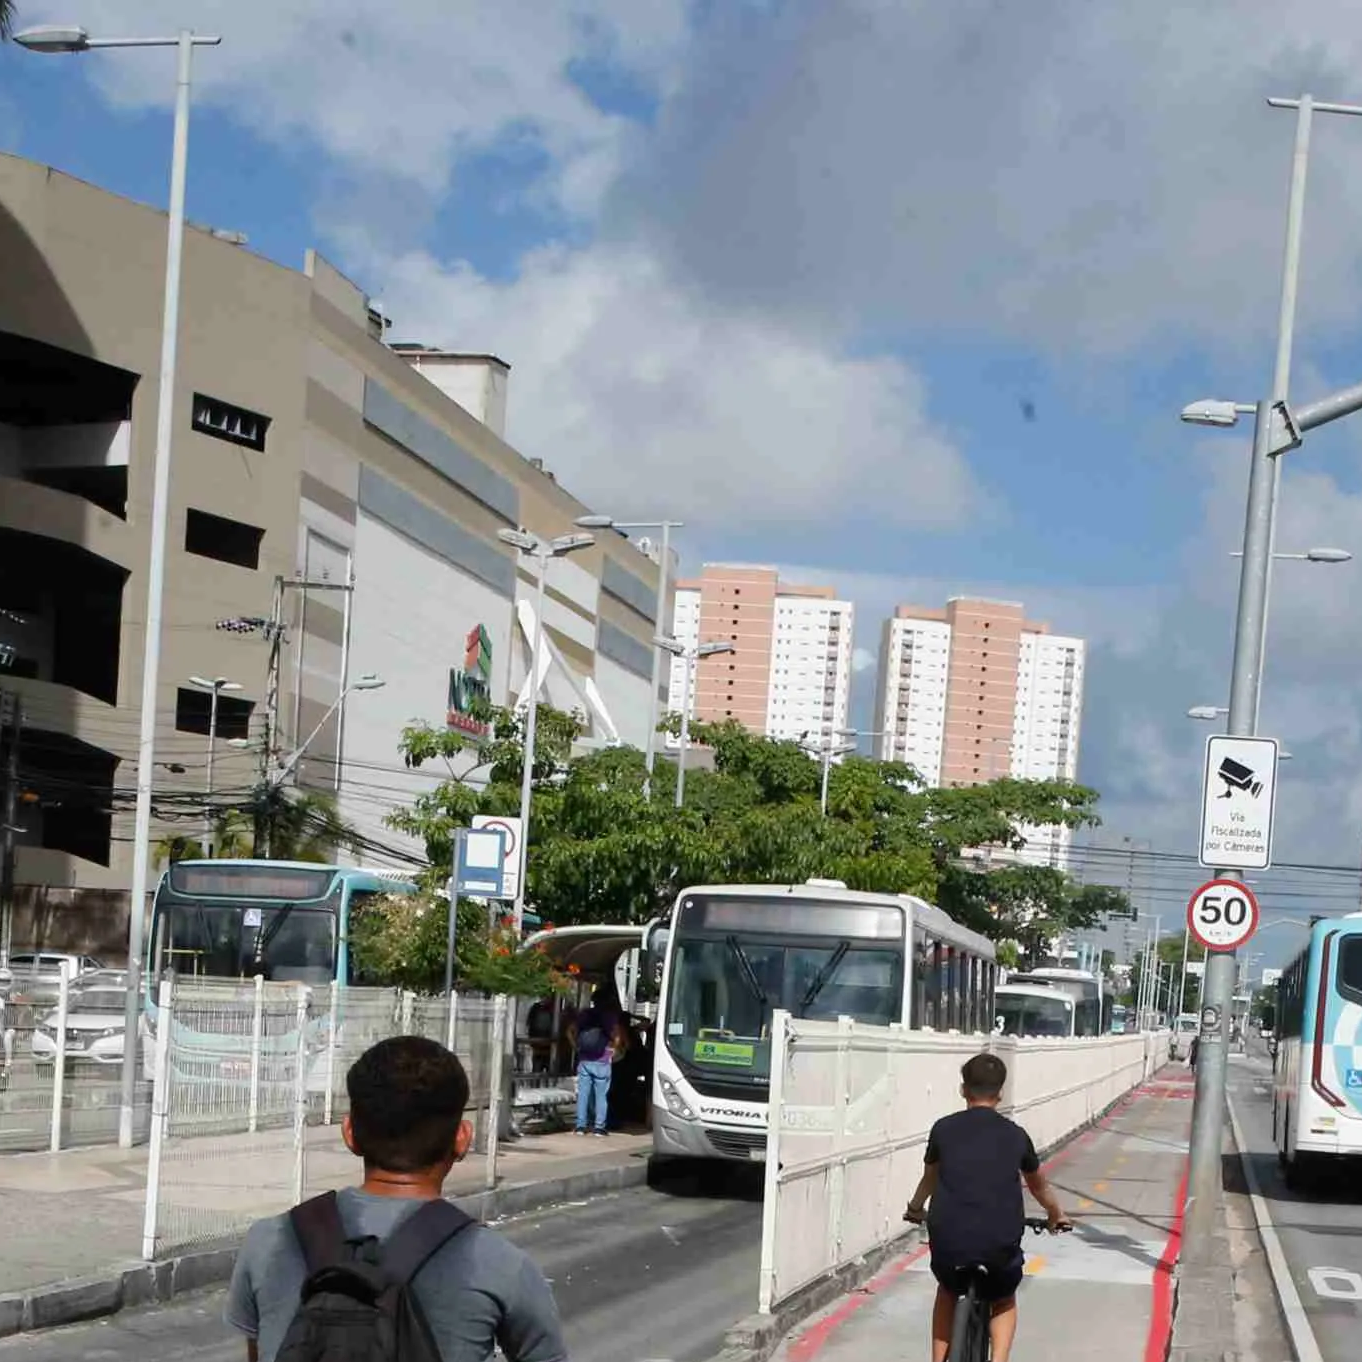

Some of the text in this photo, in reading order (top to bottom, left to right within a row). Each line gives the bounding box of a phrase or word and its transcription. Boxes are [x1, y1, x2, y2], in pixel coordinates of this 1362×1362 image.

[1229, 812, 1246, 823] Via
[1210, 825, 1263, 838] Fiscalizada
[1205, 839, 1265, 854] por Câmeras
[1199, 896, 1247, 926] 50
[699, 1106, 762, 1120] VITORIA
